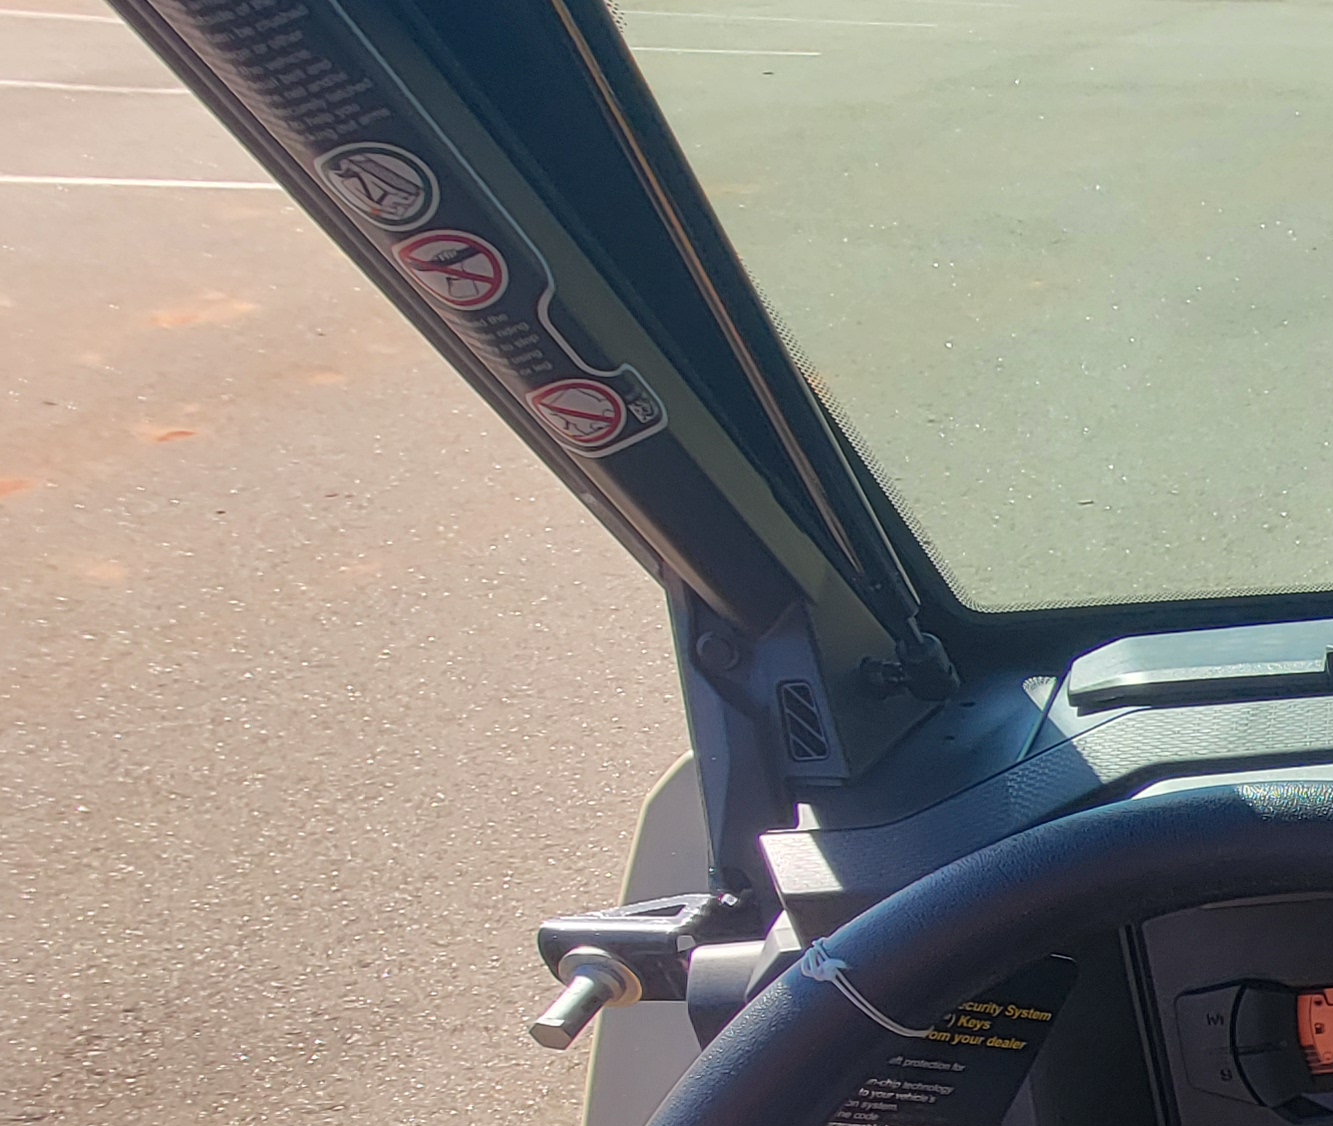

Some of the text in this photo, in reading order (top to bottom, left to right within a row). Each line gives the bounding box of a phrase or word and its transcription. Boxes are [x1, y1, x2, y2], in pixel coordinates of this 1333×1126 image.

[958, 1002, 1053, 1022] curity System
[957, 1015, 992, 1032] Keys
[951, 1033, 985, 1046] your
[986, 1036, 1027, 1051] dealer
